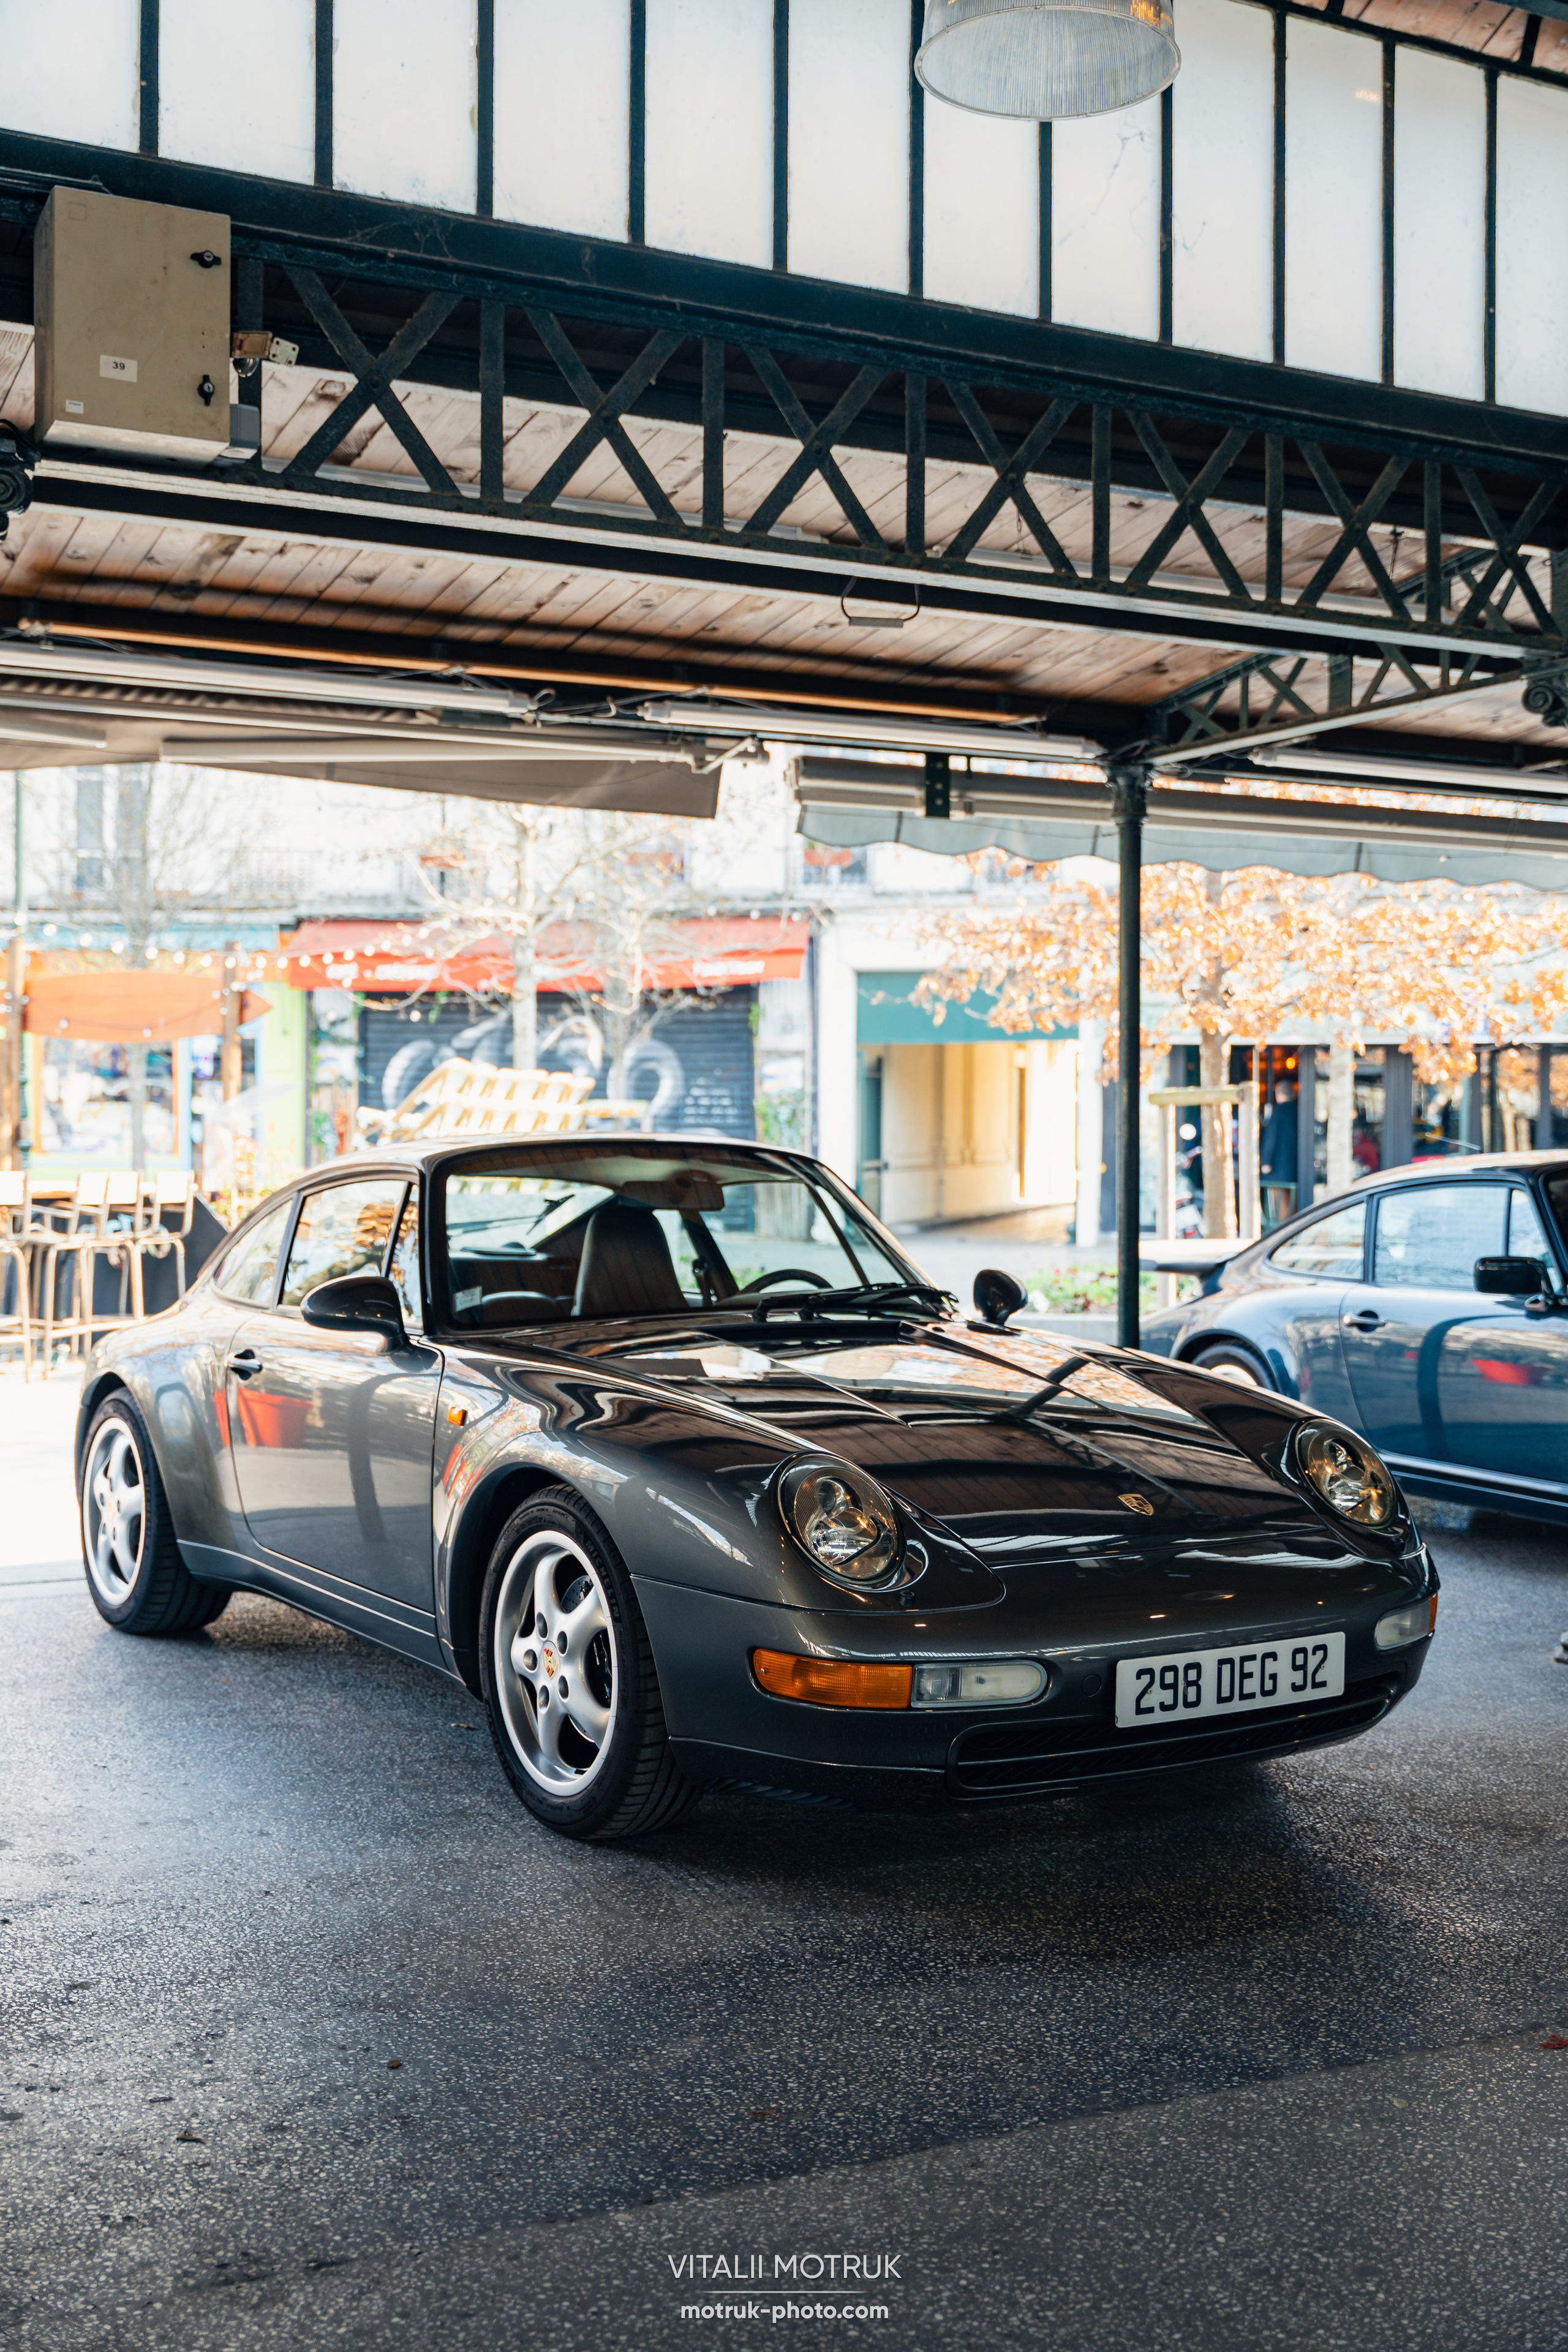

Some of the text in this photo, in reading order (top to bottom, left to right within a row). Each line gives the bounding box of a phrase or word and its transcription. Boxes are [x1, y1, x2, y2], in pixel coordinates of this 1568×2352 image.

[112, 361, 126, 371] 39
[586, 1539, 620, 1617] MICHELIN
[1135, 1643, 1328, 1716] 298 DEG 92
